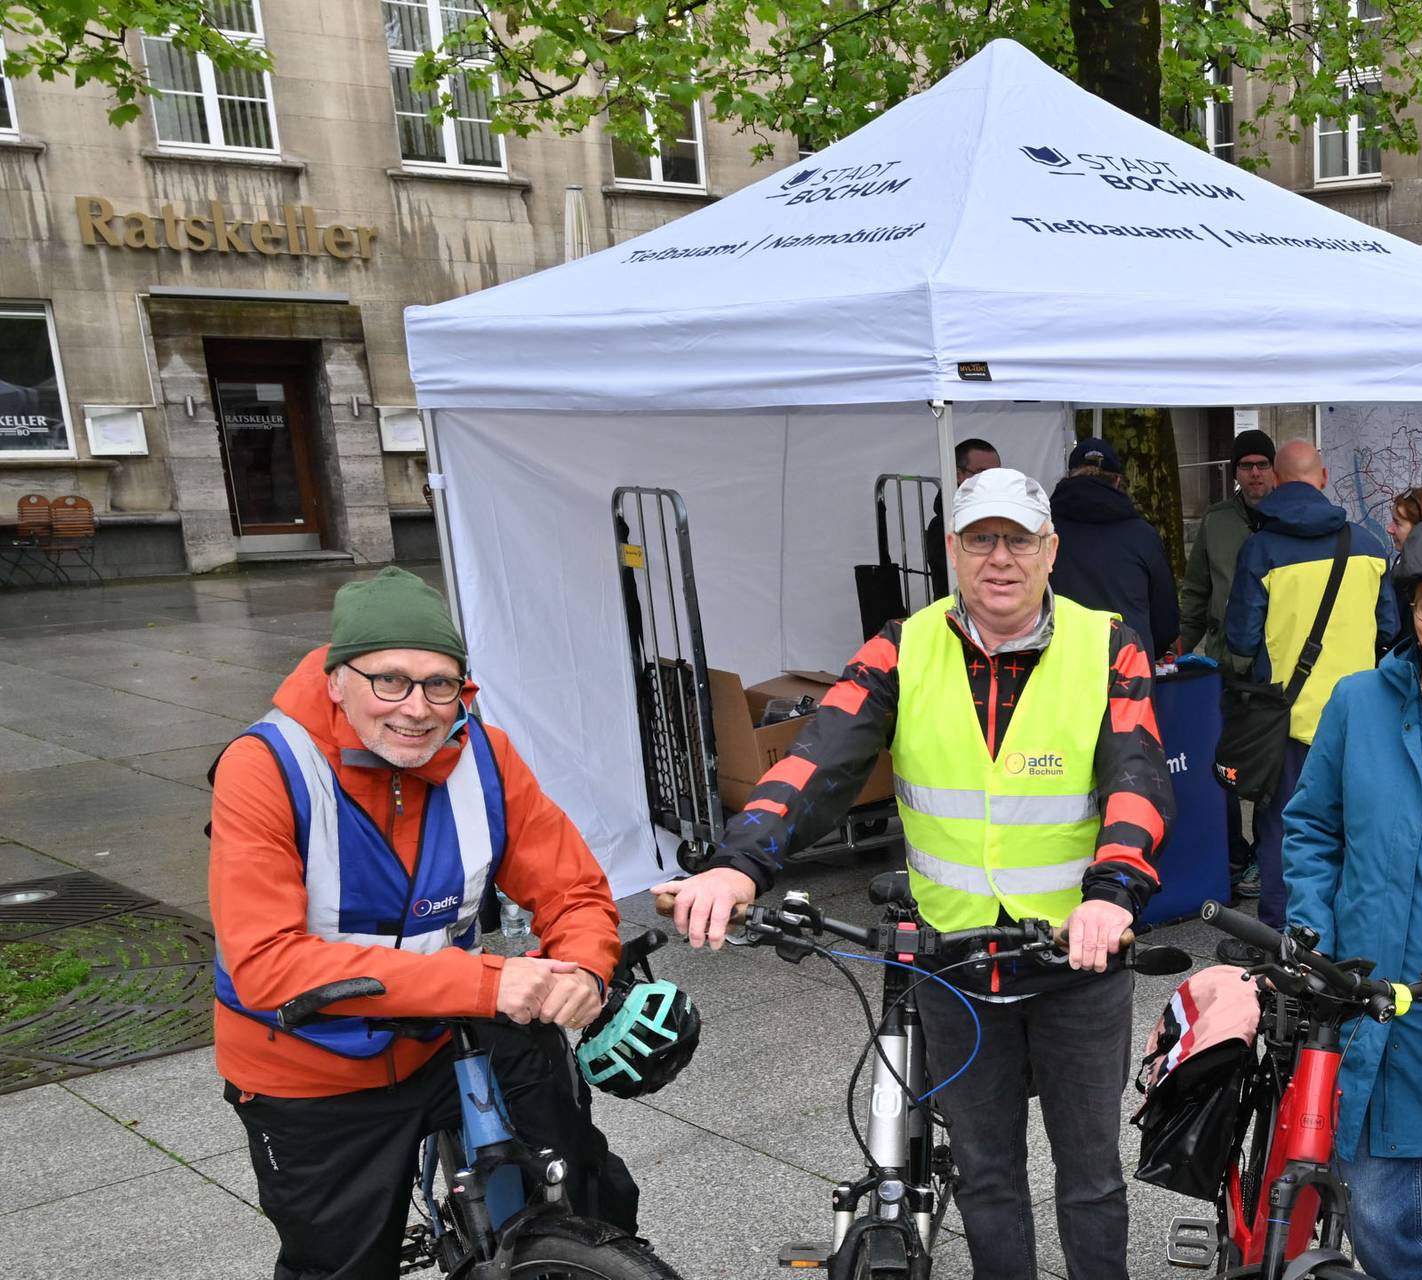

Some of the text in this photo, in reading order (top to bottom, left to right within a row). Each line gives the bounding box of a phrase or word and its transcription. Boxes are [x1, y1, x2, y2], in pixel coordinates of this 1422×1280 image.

[820, 160, 903, 187] STADT
[1078, 152, 1181, 179] STADT
[785, 177, 913, 207] BOCHUM
[1099, 174, 1247, 202] BOCHUM
[74, 195, 379, 260] Ratskeller
[1011, 216, 1205, 244] Tiefbauamt
[1223, 229, 1393, 255] Nahmobilität
[621, 240, 748, 264] Tiefbauamt
[764, 222, 927, 252] Nahmobilität
[225, 415, 284, 425] RATSKELLER
[1028, 754, 1063, 767] adfc
[432, 895, 459, 910] adfc
